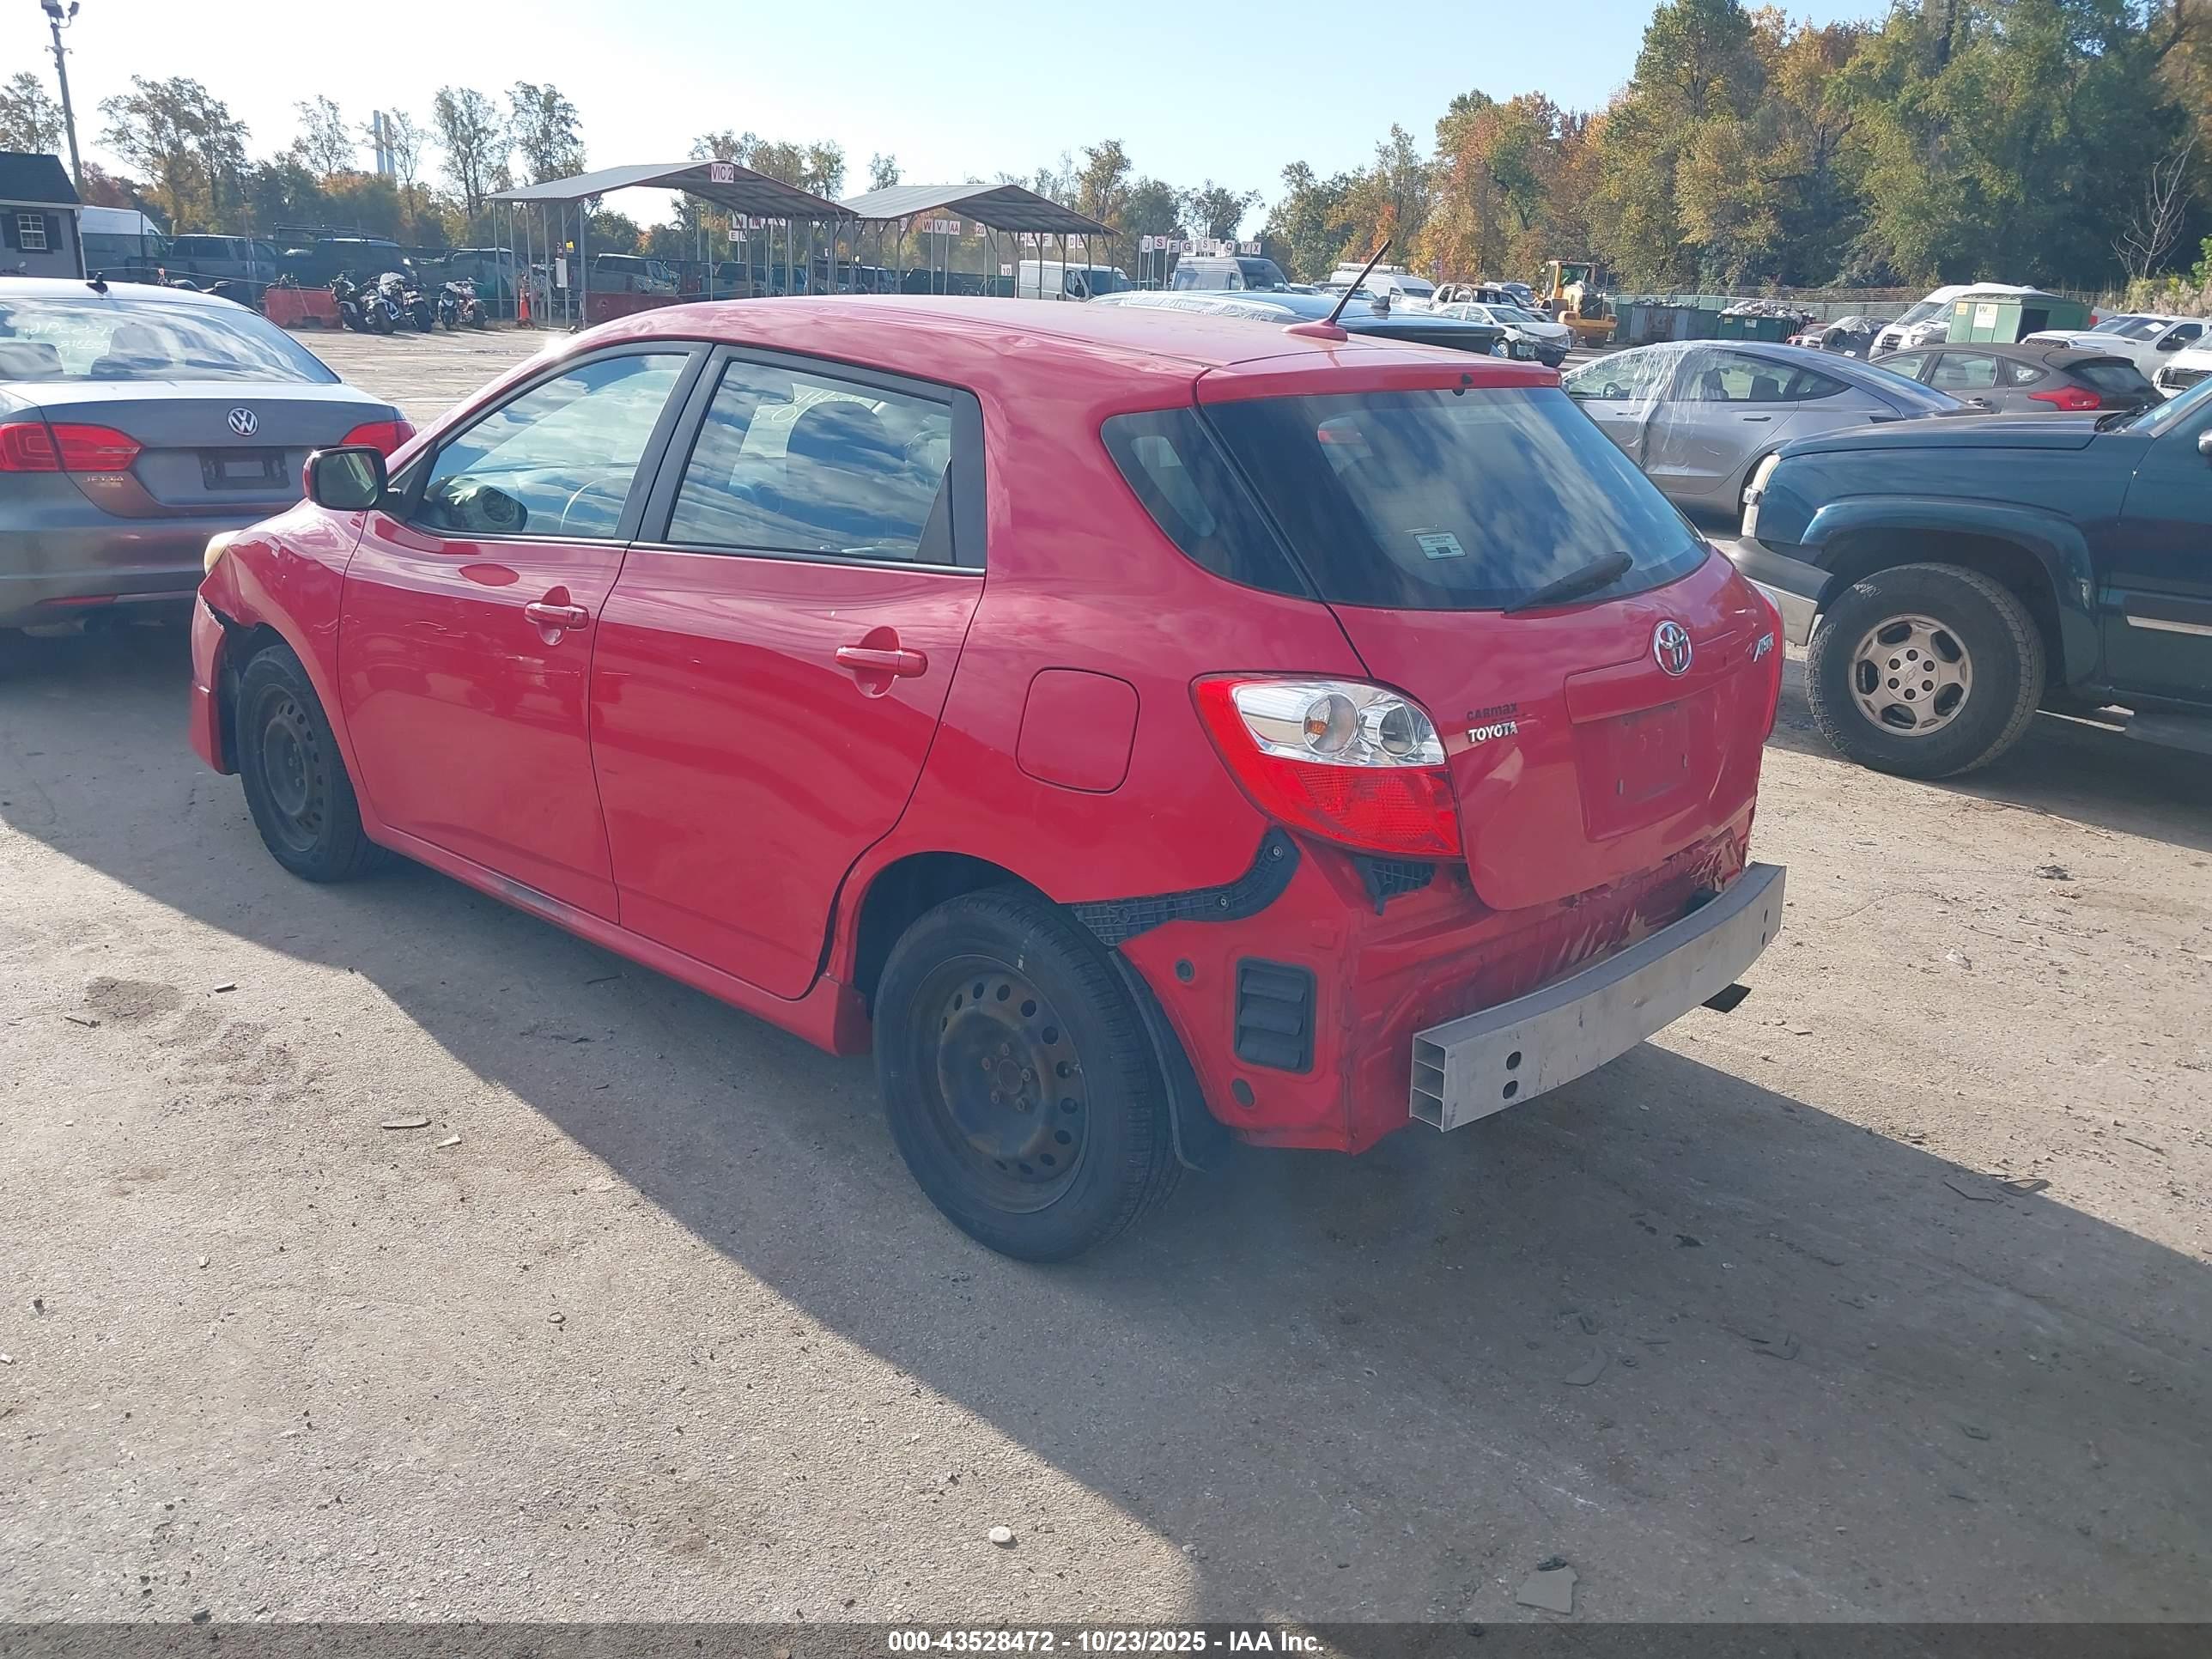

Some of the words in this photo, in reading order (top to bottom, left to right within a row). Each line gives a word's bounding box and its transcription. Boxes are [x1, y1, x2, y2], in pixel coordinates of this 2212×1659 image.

[712, 166, 726, 180] VIC
[727, 167, 733, 180] 2
[923, 220, 933, 230] W
[935, 222, 944, 231] V
[950, 223, 959, 234] AA
[976, 225, 985, 234] 20
[1156, 238, 1163, 247] S
[1170, 242, 1176, 251] F
[1183, 242, 1192, 251] G
[1202, 240, 1208, 248] S
[1212, 240, 1218, 249] T
[1243, 241, 1249, 251] Y
[1254, 243, 1261, 252] X
[1467, 721, 1518, 742] TOYOTA
